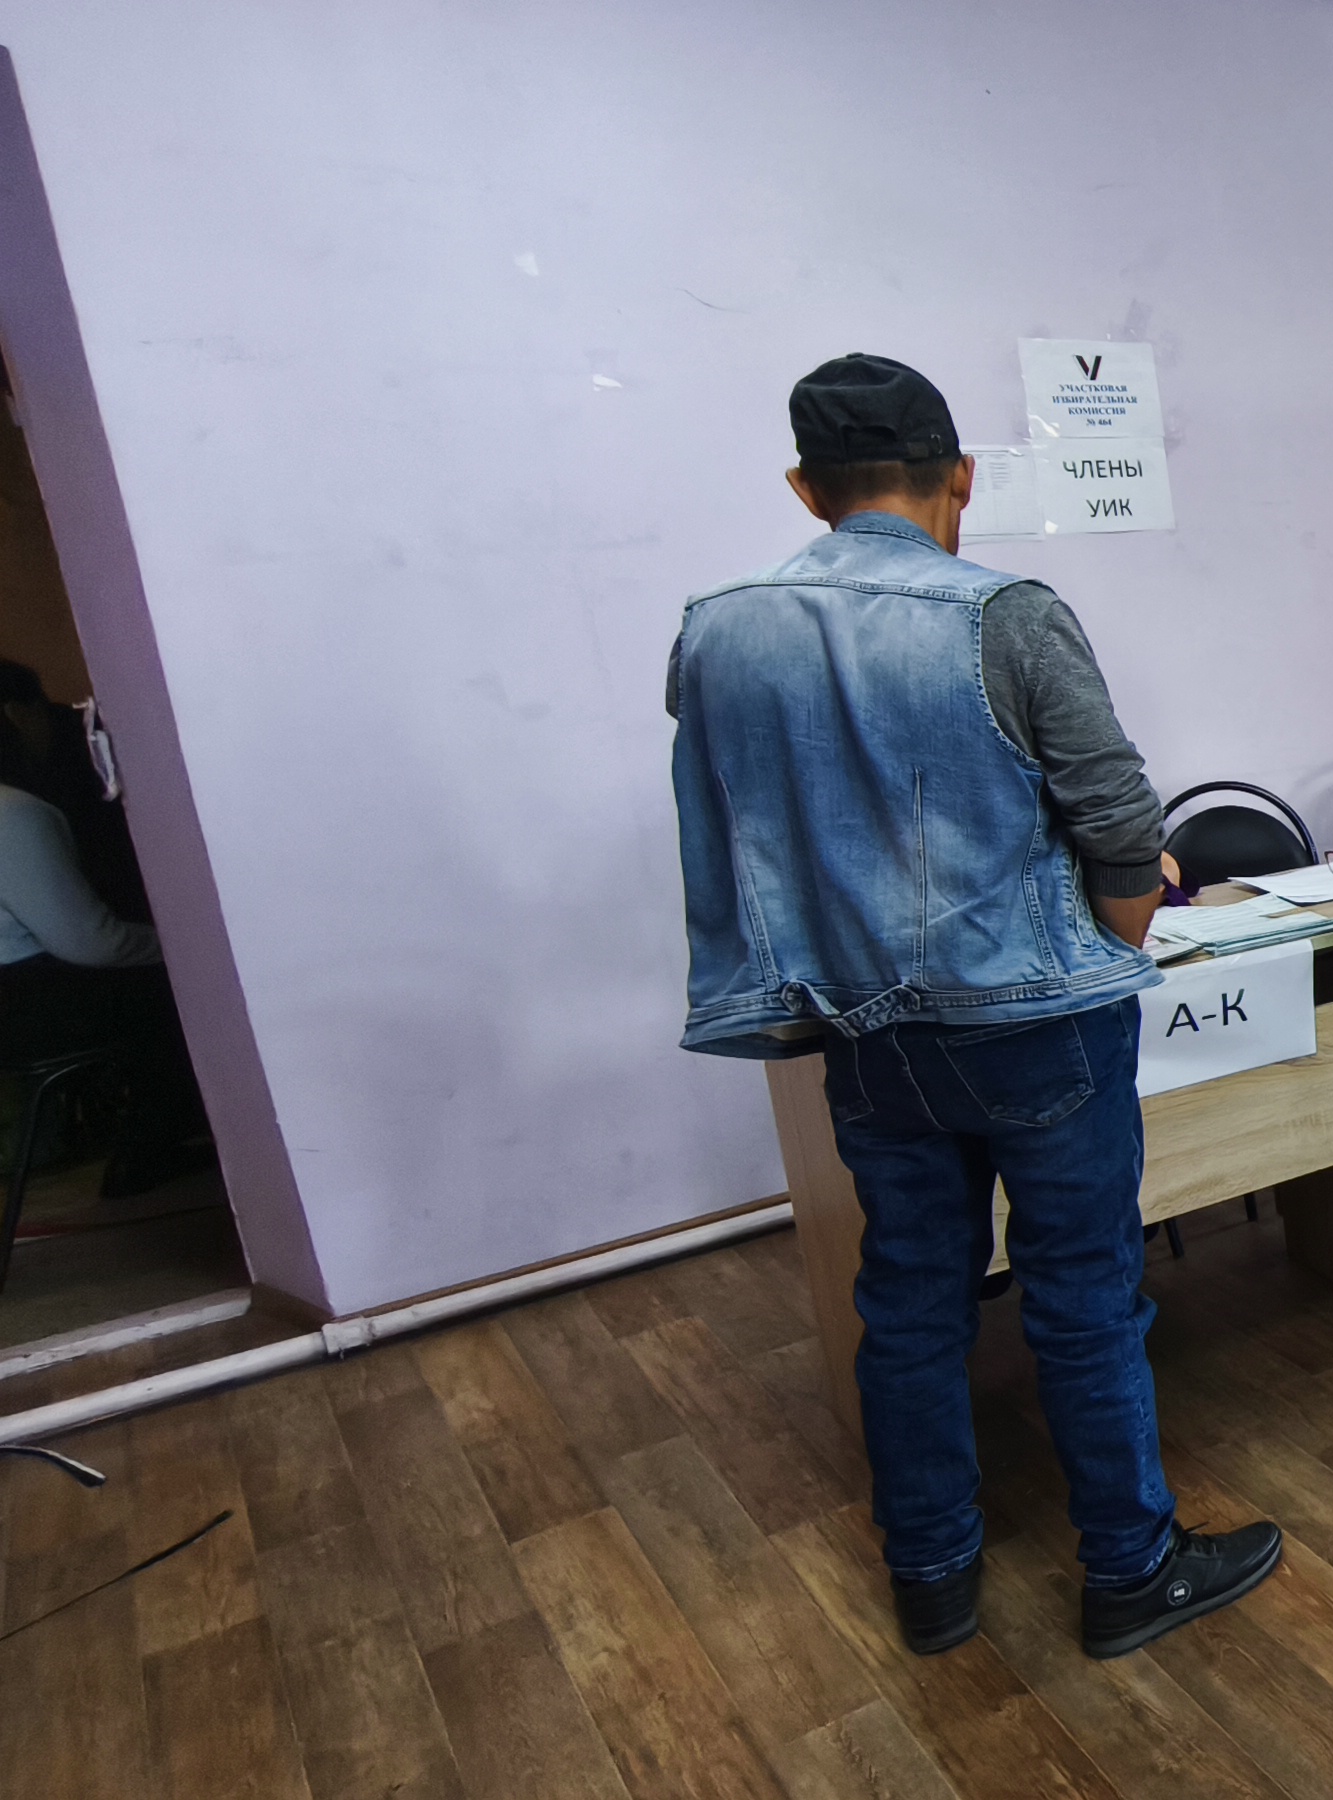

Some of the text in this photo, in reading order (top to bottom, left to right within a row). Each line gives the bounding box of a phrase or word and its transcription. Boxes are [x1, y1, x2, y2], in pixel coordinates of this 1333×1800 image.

[1059, 384, 1128, 393] УЧАСТКОВАЯ
[1052, 395, 1138, 404] ИЗБИРАТЕЛЬНАЯ
[1068, 406, 1126, 415] КОМИССИЯ
[1062, 459, 1143, 479] ЧЛЕНЫ
[1086, 498, 1133, 518] УИК
[1166, 988, 1248, 1038] А-К
